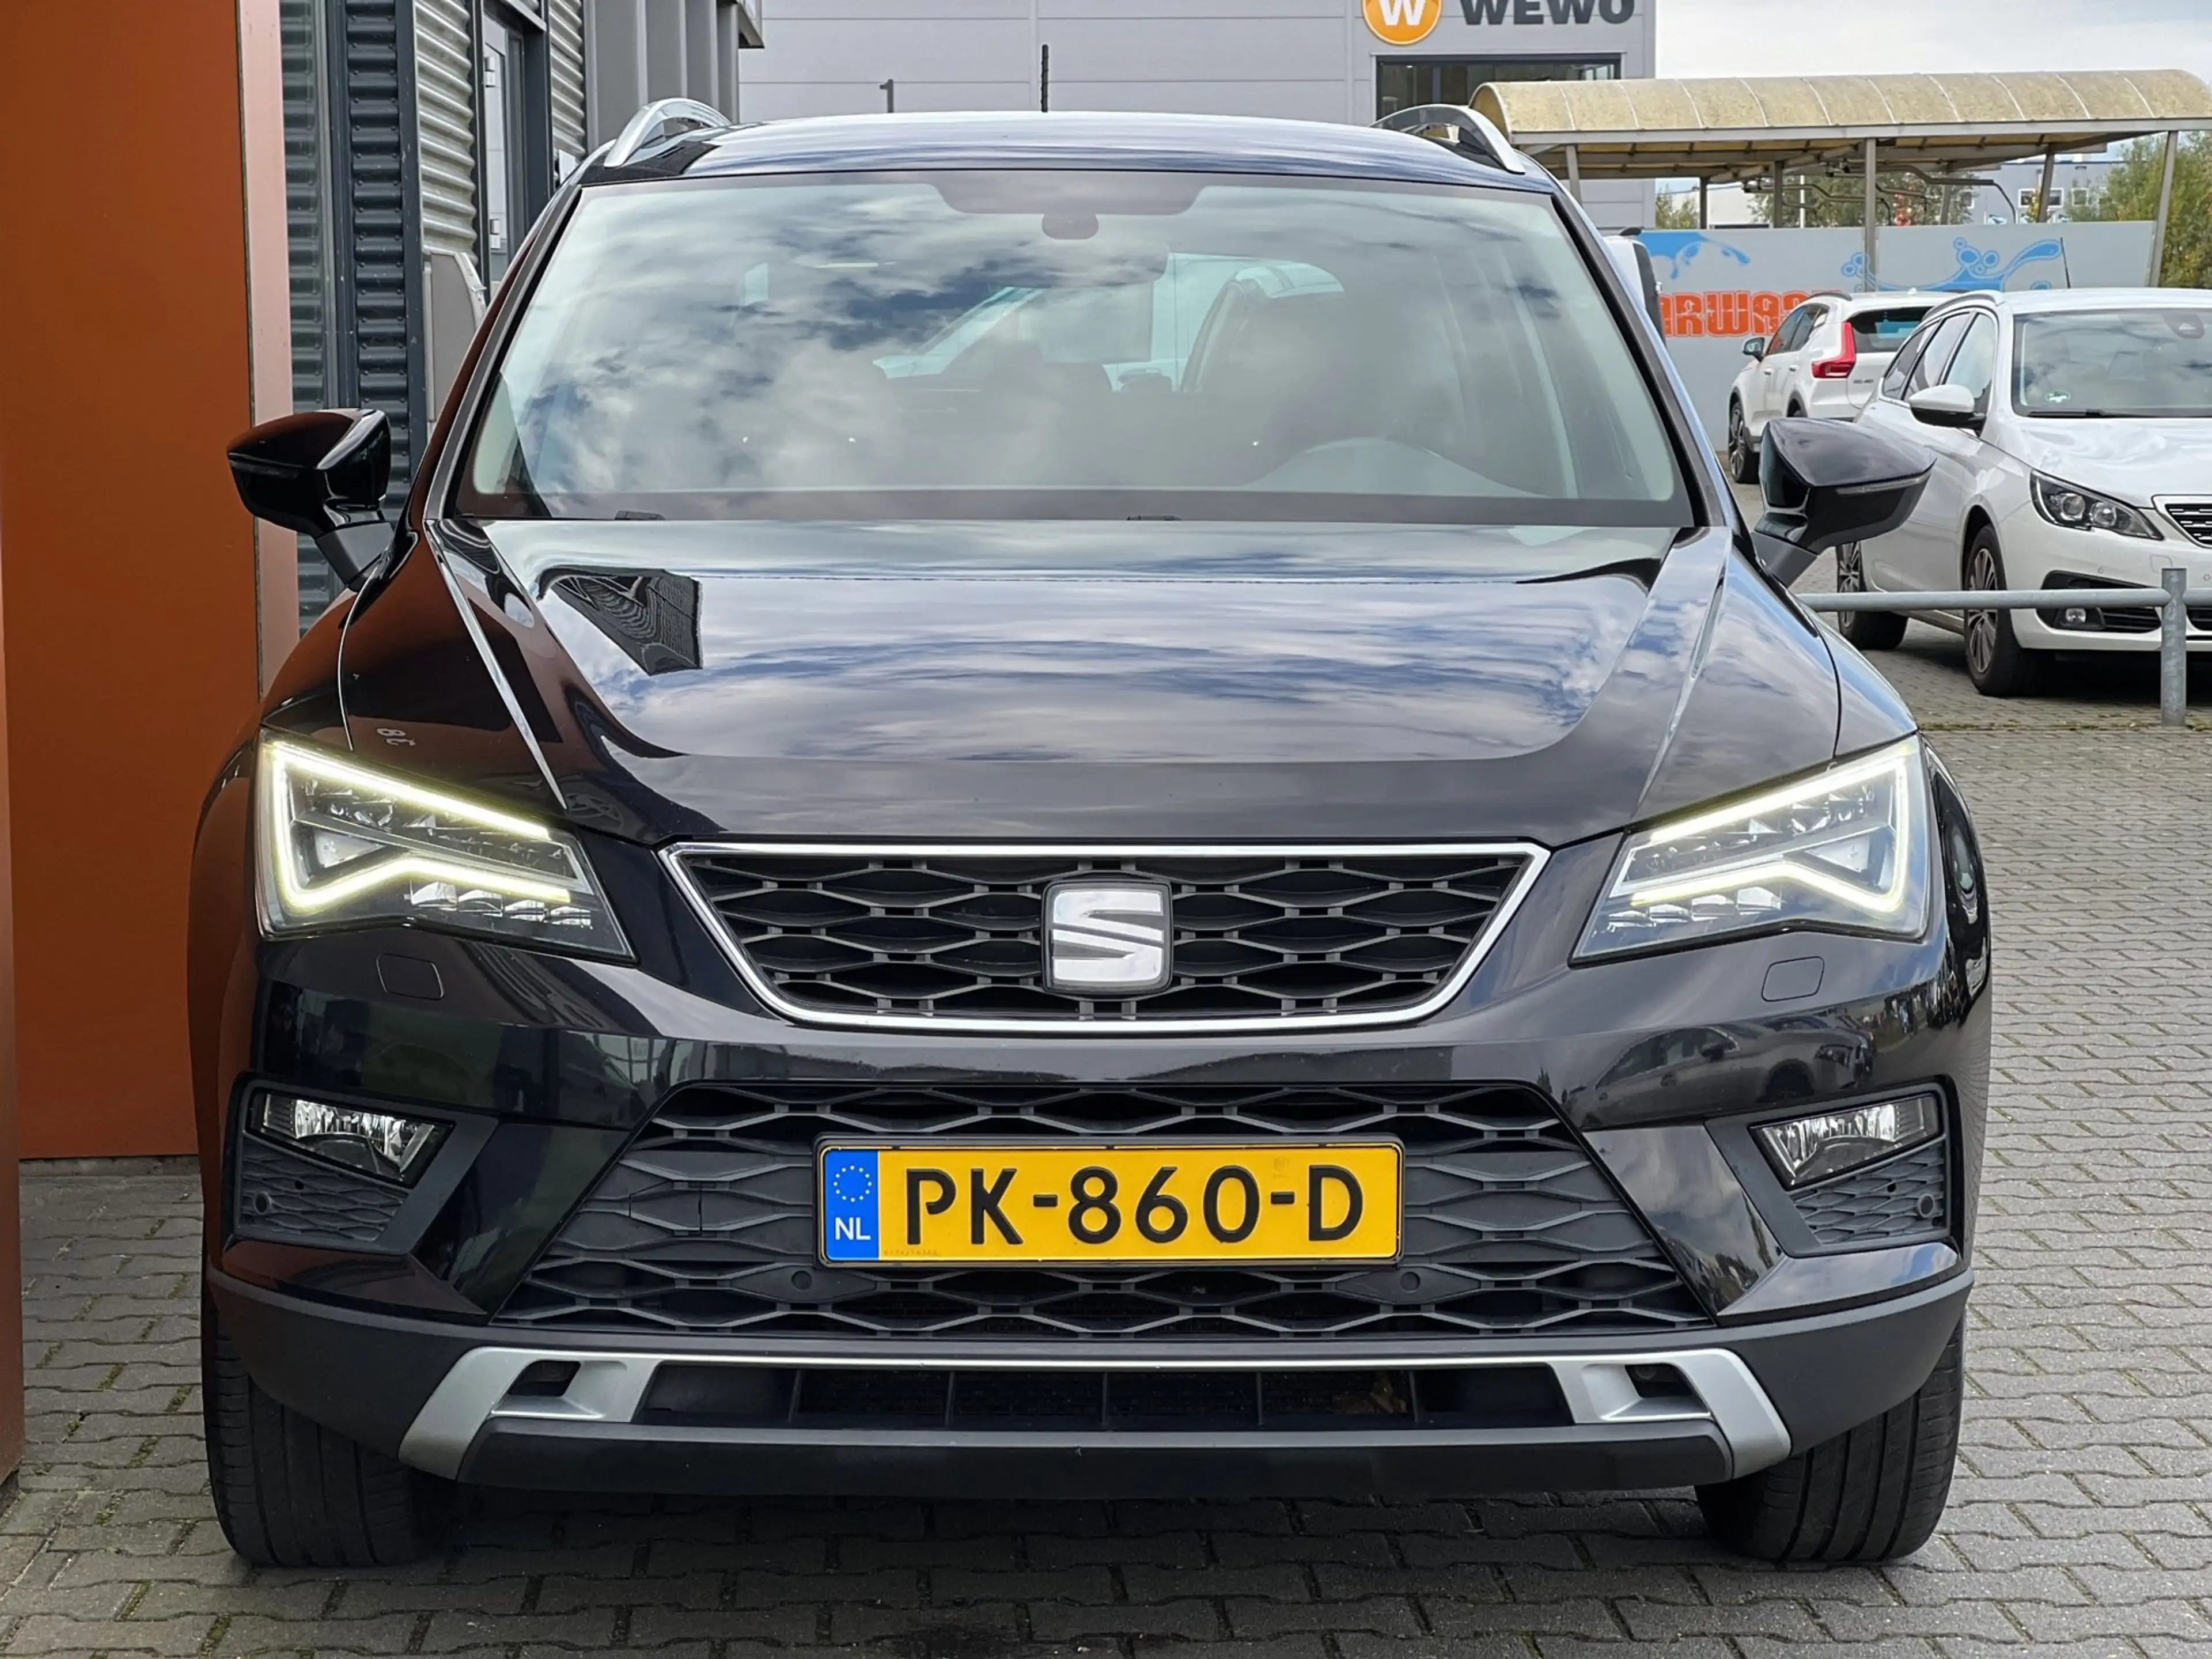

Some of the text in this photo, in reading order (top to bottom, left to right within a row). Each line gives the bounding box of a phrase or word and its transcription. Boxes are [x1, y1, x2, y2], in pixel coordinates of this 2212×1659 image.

[1460, 0, 1635, 25] WEWO
[906, 1165, 1363, 1245] PK-860-D
[835, 1217, 871, 1240] NL
